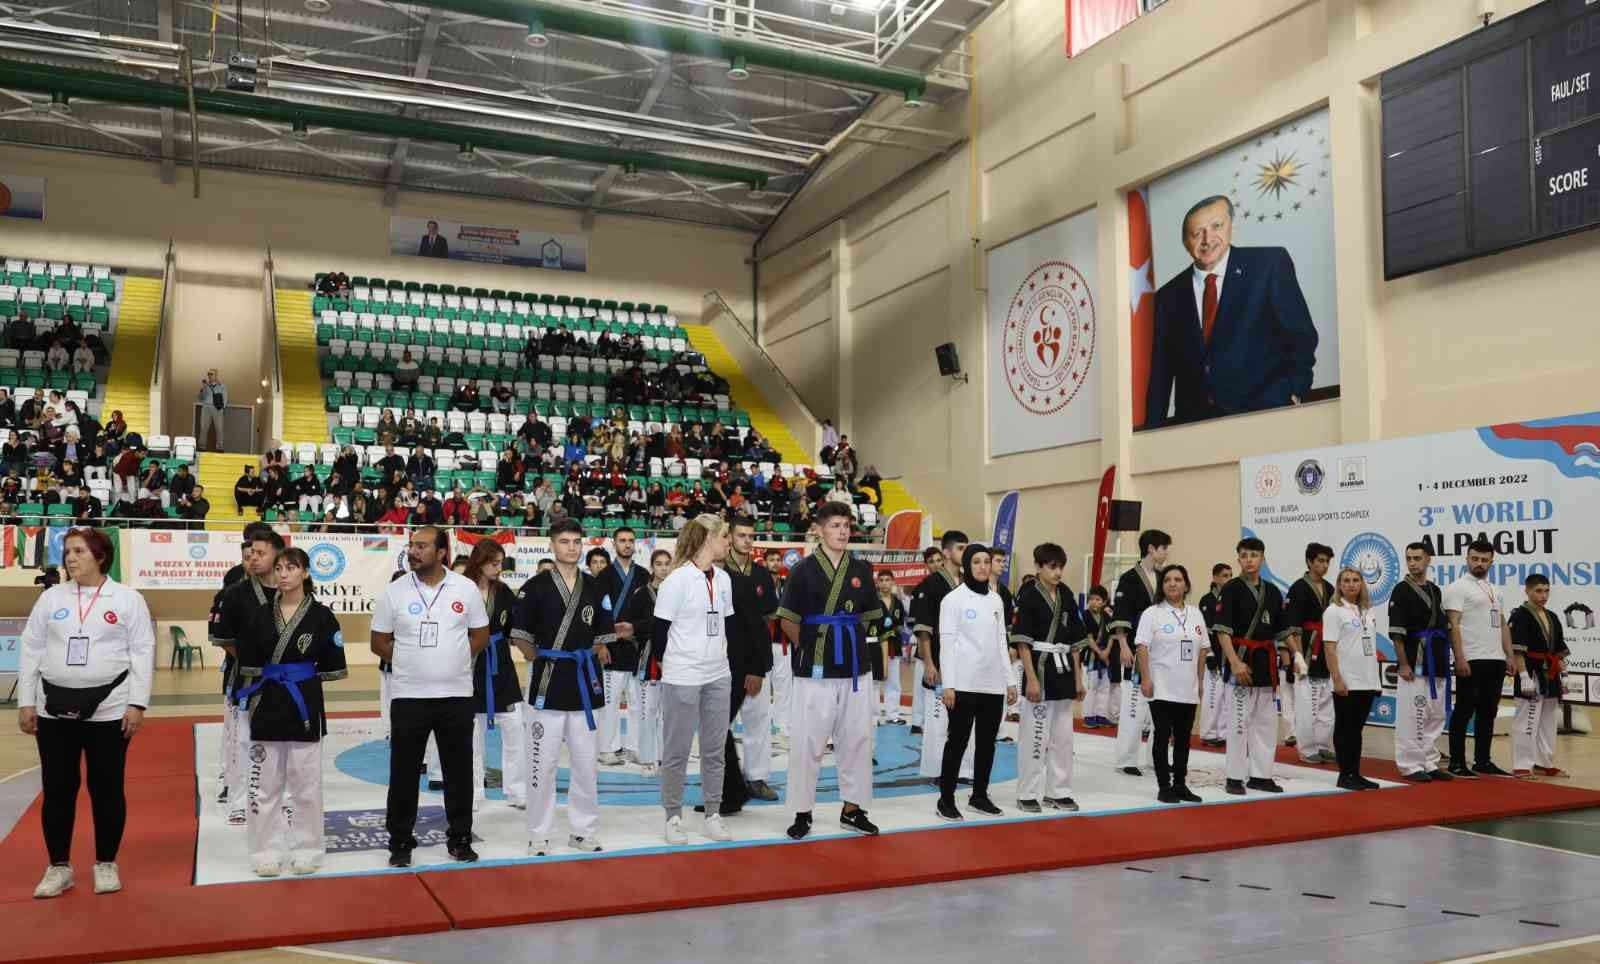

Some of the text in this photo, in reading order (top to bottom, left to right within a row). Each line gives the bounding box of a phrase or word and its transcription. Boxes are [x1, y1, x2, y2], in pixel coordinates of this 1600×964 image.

[1551, 72, 1591, 102] FAUL/SET
[1549, 168, 1588, 196] SCORE
[1417, 482, 1423, 492] 1
[1432, 481, 1439, 491] 4
[1442, 475, 1496, 490] DECEMBER
[1499, 473, 1529, 485] 2022
[1341, 509, 1371, 521] COMPLEX
[1451, 498, 1554, 525] WORLD
[1427, 561, 1600, 586] HPIONS
